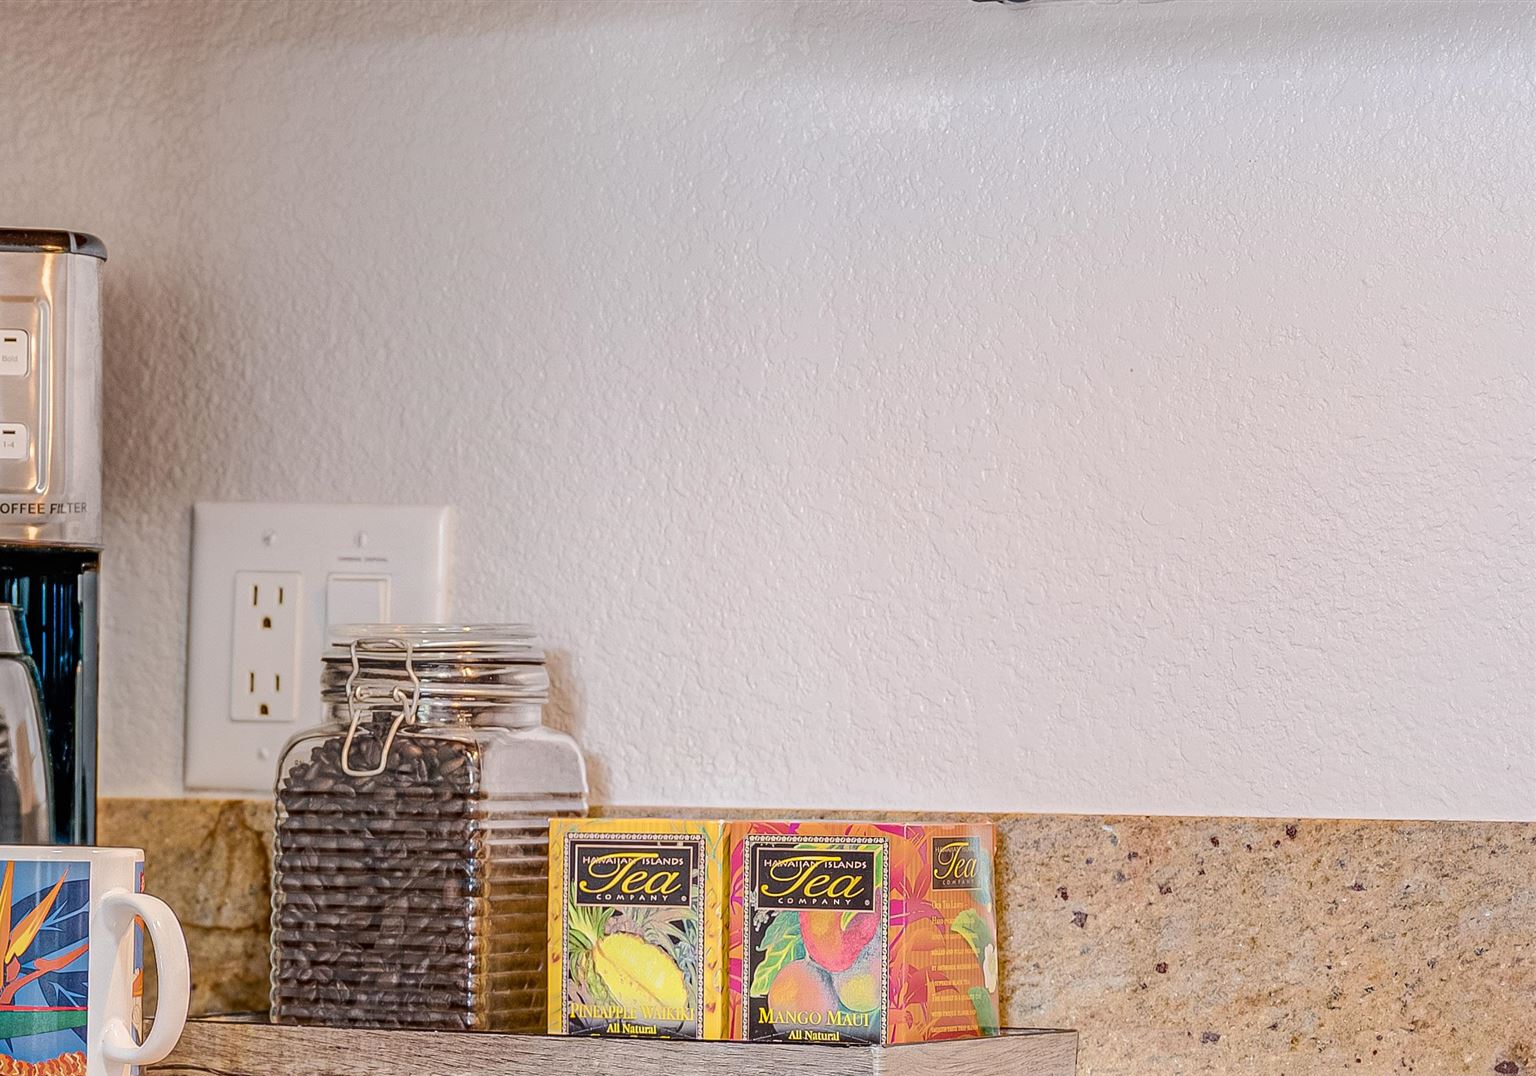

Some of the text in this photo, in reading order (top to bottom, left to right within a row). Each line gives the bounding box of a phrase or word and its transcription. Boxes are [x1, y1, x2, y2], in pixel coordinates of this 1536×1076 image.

[50, 502, 88, 515] FILTER
[582, 856, 684, 866] HAWAIIAN ISLANDS
[764, 859, 867, 869] HAWAIIAN ISLANDS
[933, 841, 977, 880] Tea
[579, 853, 682, 895] Tea
[761, 856, 865, 898] Tea
[596, 893, 669, 901] COMPANY
[778, 897, 852, 906] COMPANY
[570, 1003, 695, 1020] PINEAPPLE WAIKIKI
[758, 1007, 870, 1027] MANGO MAUI
[606, 1022, 657, 1035] All Natural
[788, 1029, 840, 1041] All Natural
